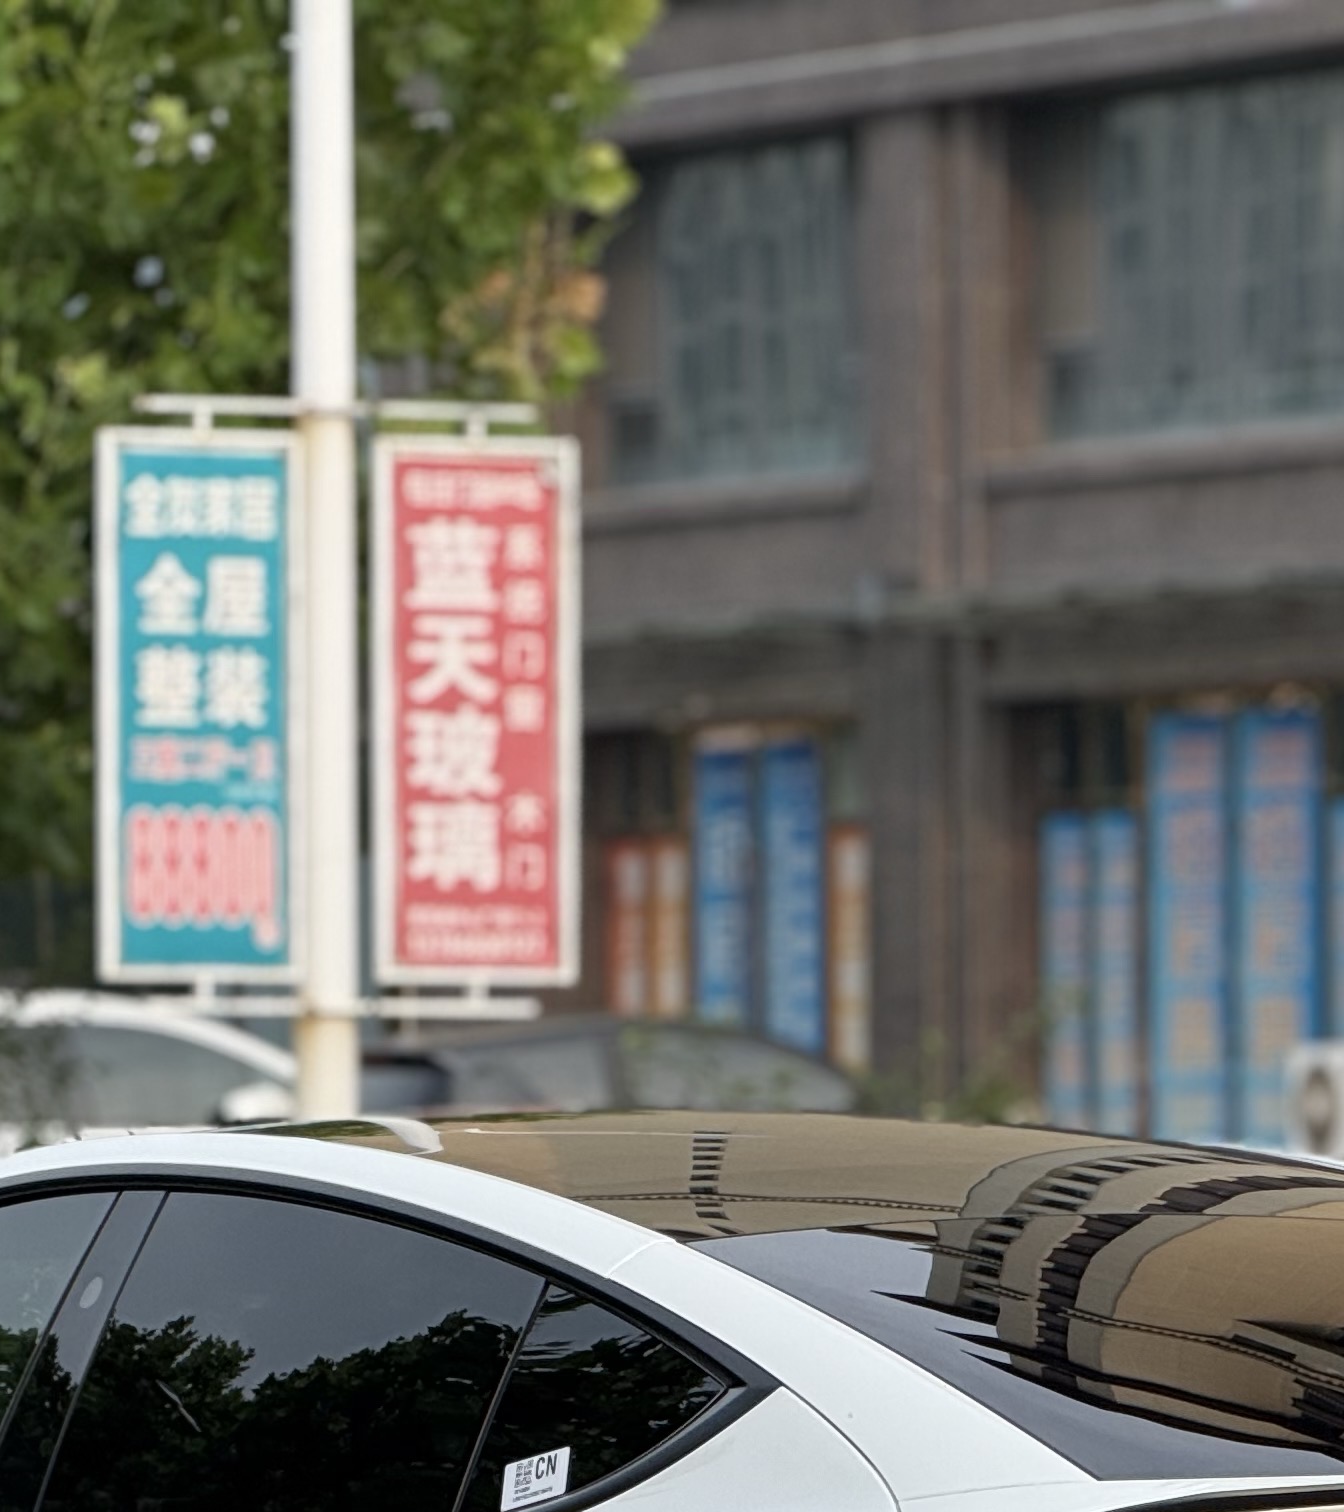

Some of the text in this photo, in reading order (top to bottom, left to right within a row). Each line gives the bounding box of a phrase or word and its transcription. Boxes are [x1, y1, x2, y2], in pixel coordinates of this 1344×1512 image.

[134, 552, 269, 637] 全屋
[134, 644, 269, 729] 整装
[404, 516, 503, 894] 蓝天玻璃
[535, 1452, 558, 1480] CN
